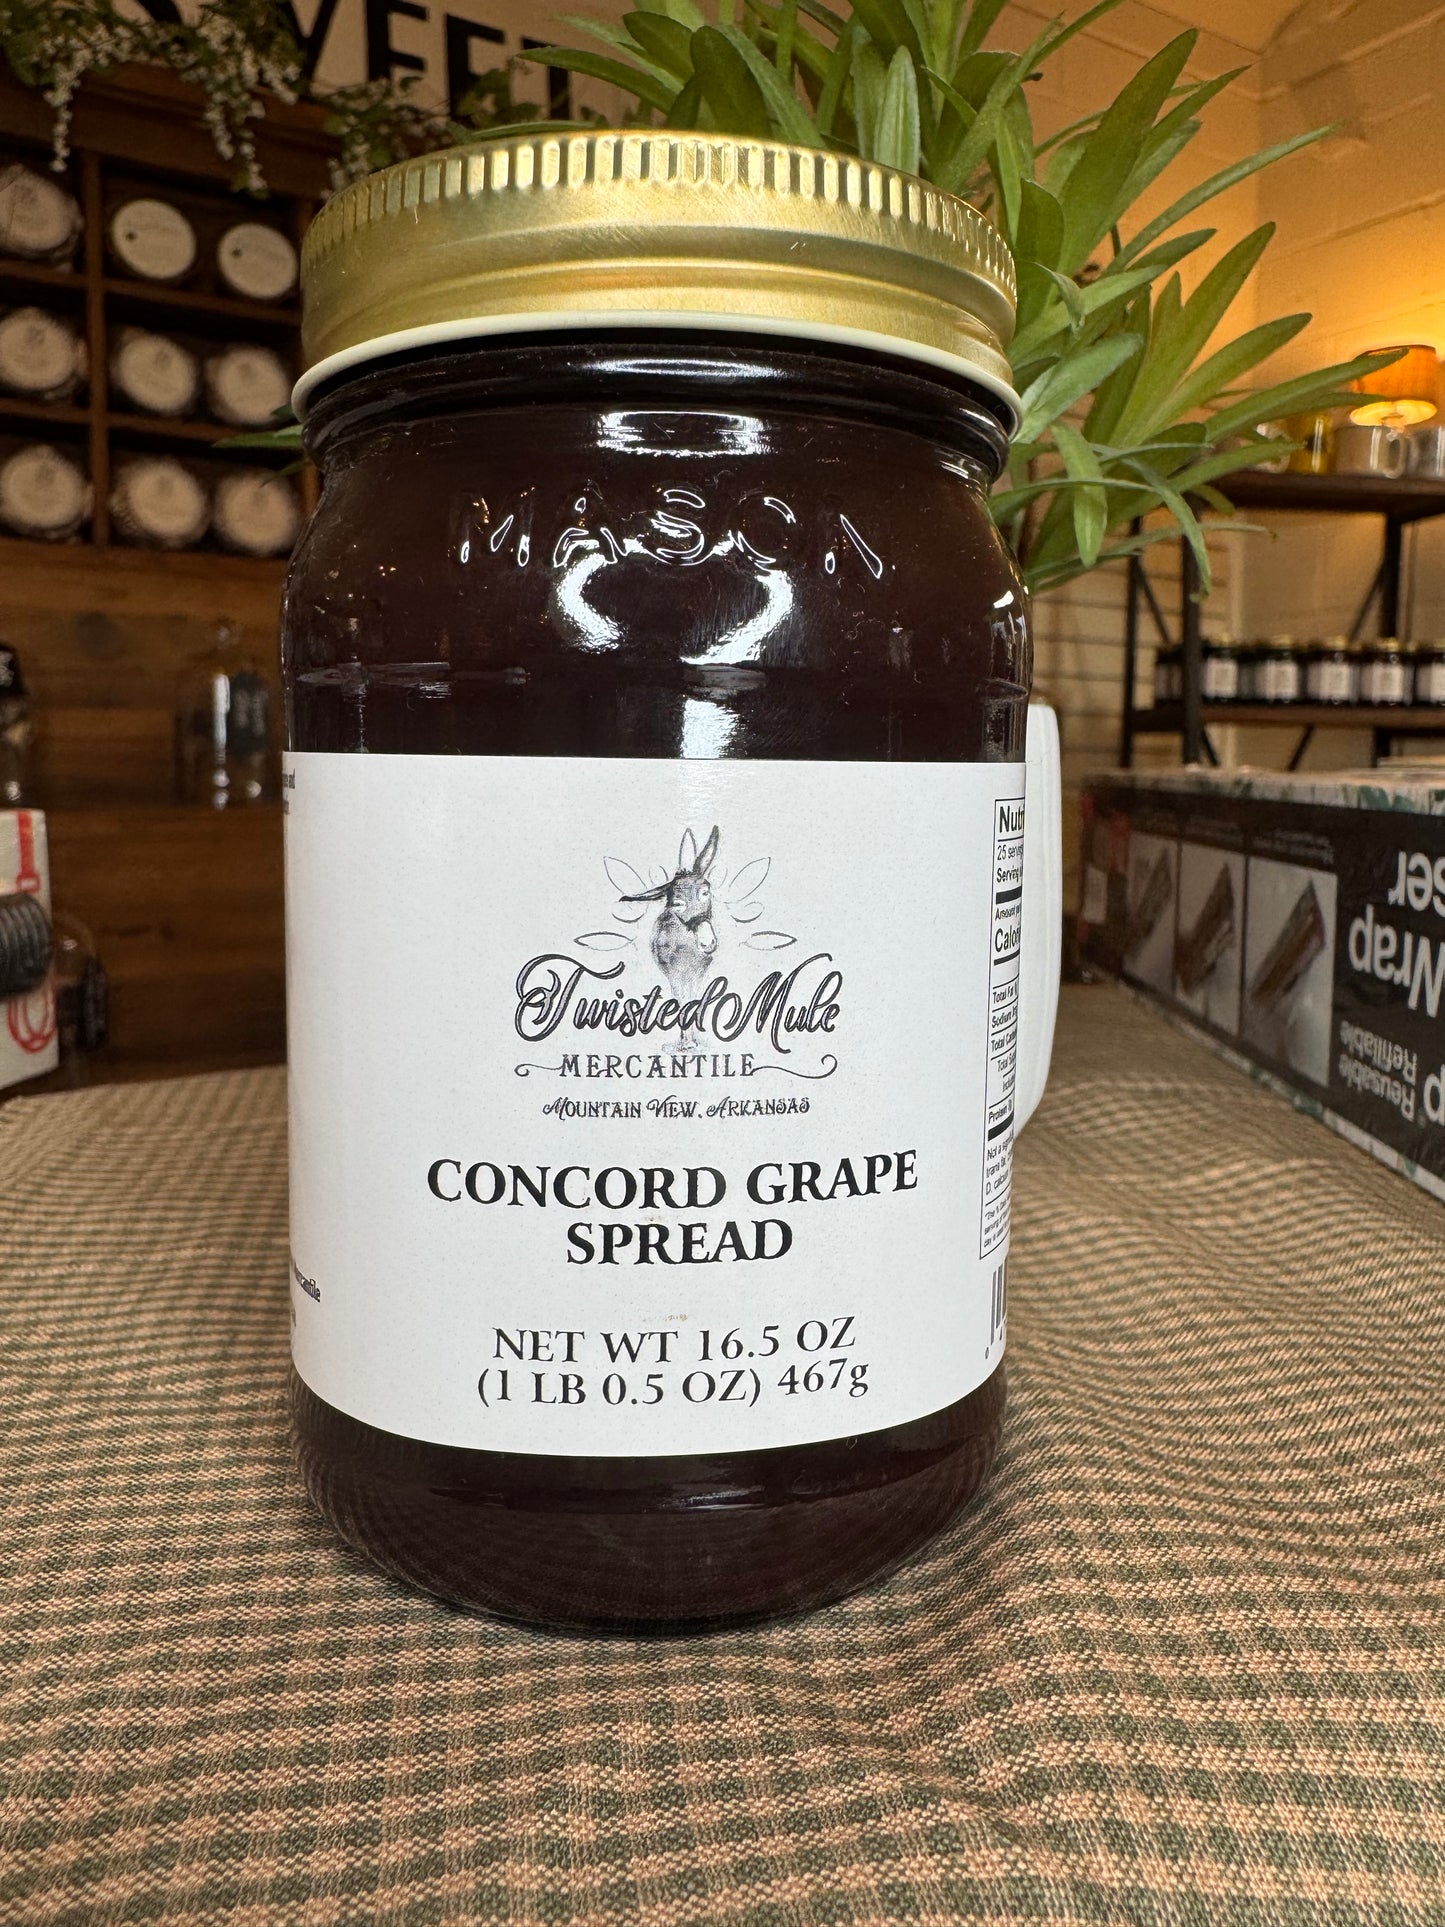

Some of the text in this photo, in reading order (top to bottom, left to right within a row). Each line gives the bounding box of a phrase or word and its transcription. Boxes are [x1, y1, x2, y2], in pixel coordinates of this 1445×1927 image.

[514, 953, 843, 1054] Twisted Mule
[559, 1054, 755, 1079] MERCANTILE
[1340, 1019, 1417, 1082] Refillable
[1338, 1054, 1416, 1121] Reusable
[427, 1149, 918, 1210] CONCORD GRAPE
[566, 1218, 794, 1267] SPREAD
[492, 1315, 857, 1364] NET WT 16.5 OZ
[478, 1358, 871, 1408] (1 LB 0.5 OZ) 467g
